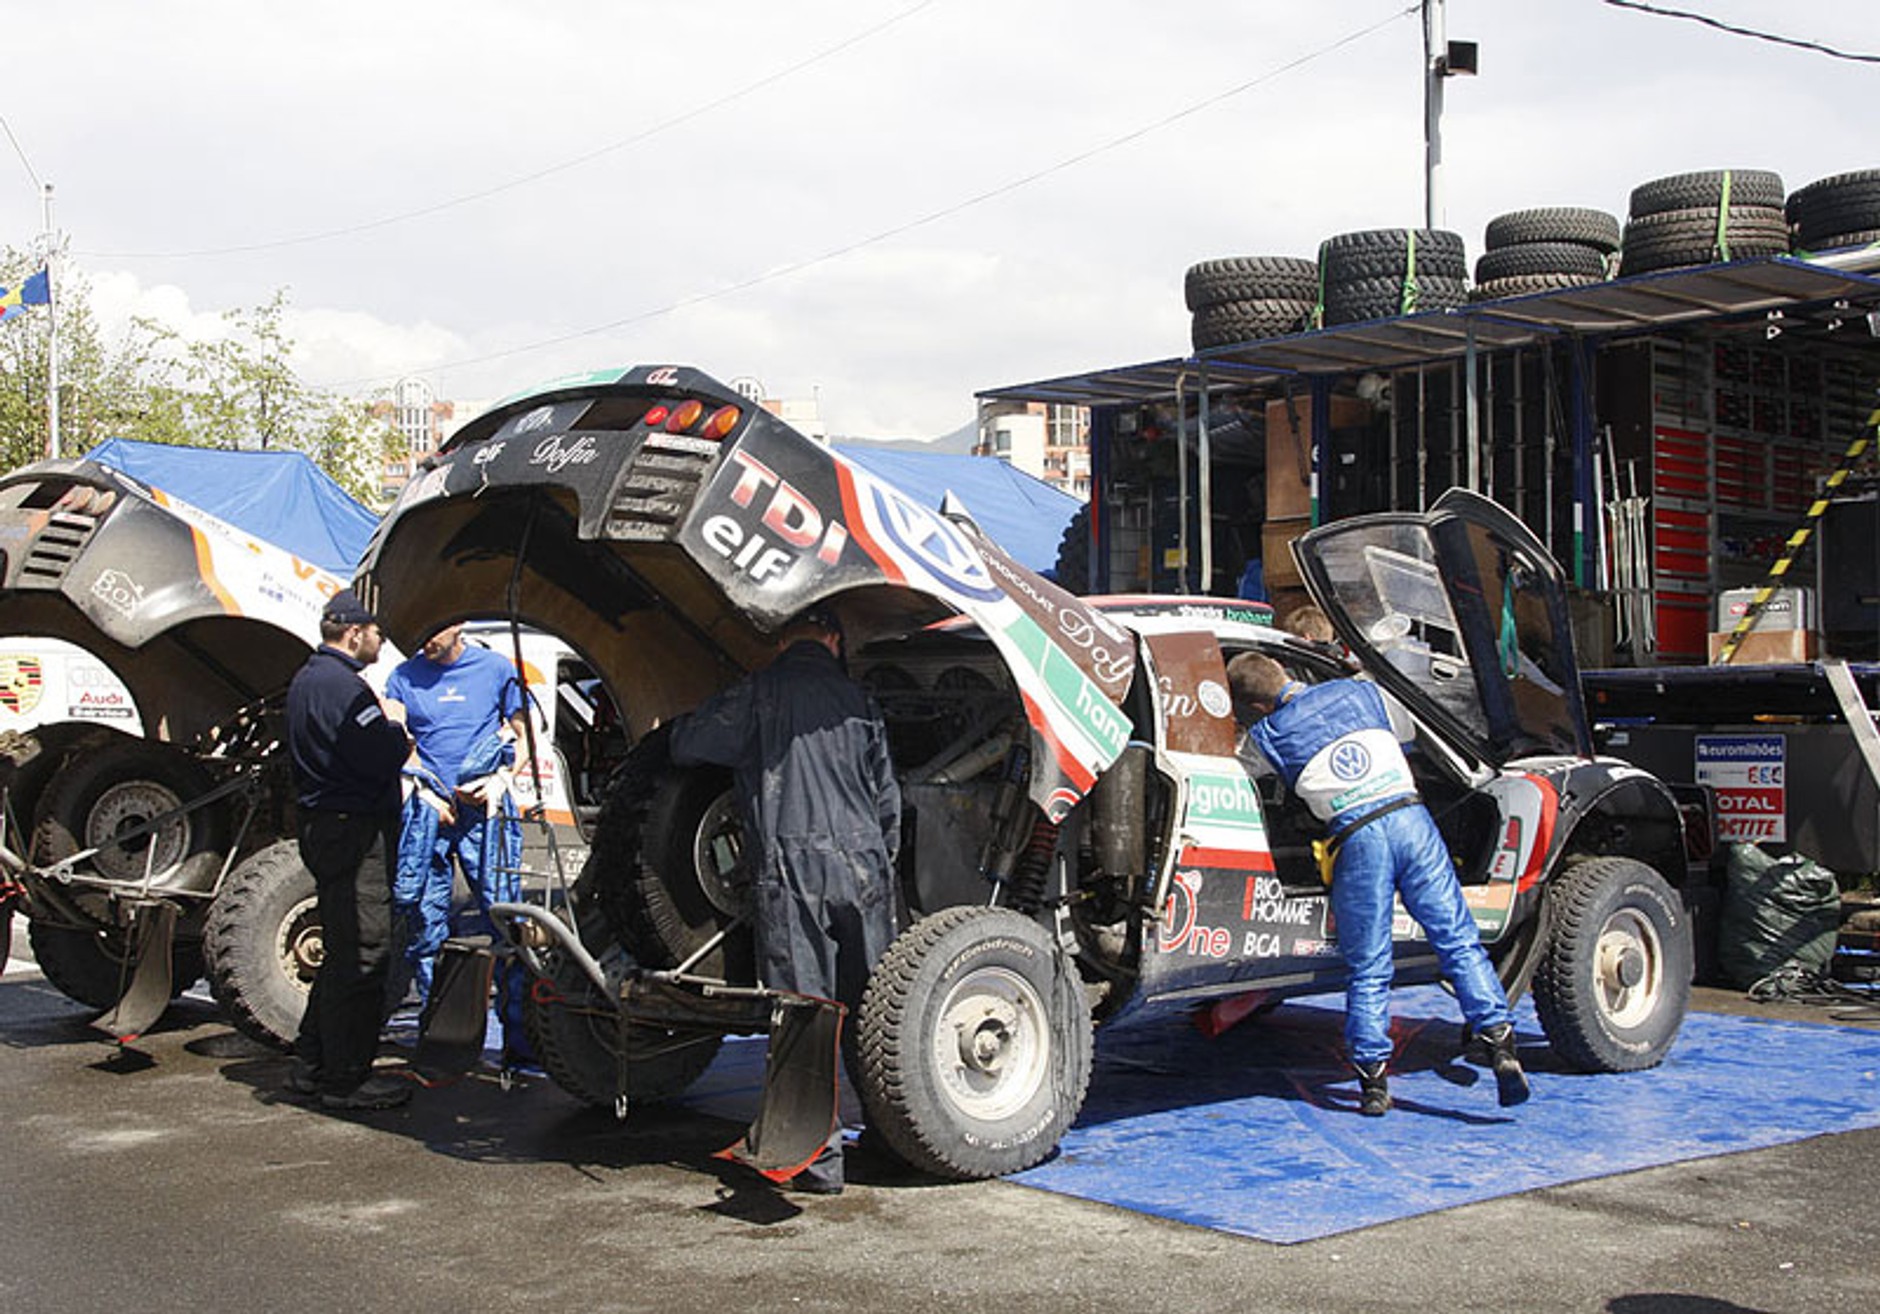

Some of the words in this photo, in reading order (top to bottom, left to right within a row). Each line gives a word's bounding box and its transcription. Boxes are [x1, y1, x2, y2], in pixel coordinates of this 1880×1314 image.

[529, 435, 600, 474] Dolfin
[730, 451, 848, 565] TDI
[702, 514, 798, 586] elf
[80, 691, 123, 704] Audi
[1715, 793, 1776, 810] OTAL
[1718, 818, 1777, 836] OCTITE
[1251, 899, 1314, 926] HOMME
[1243, 932, 1280, 957] BCA
